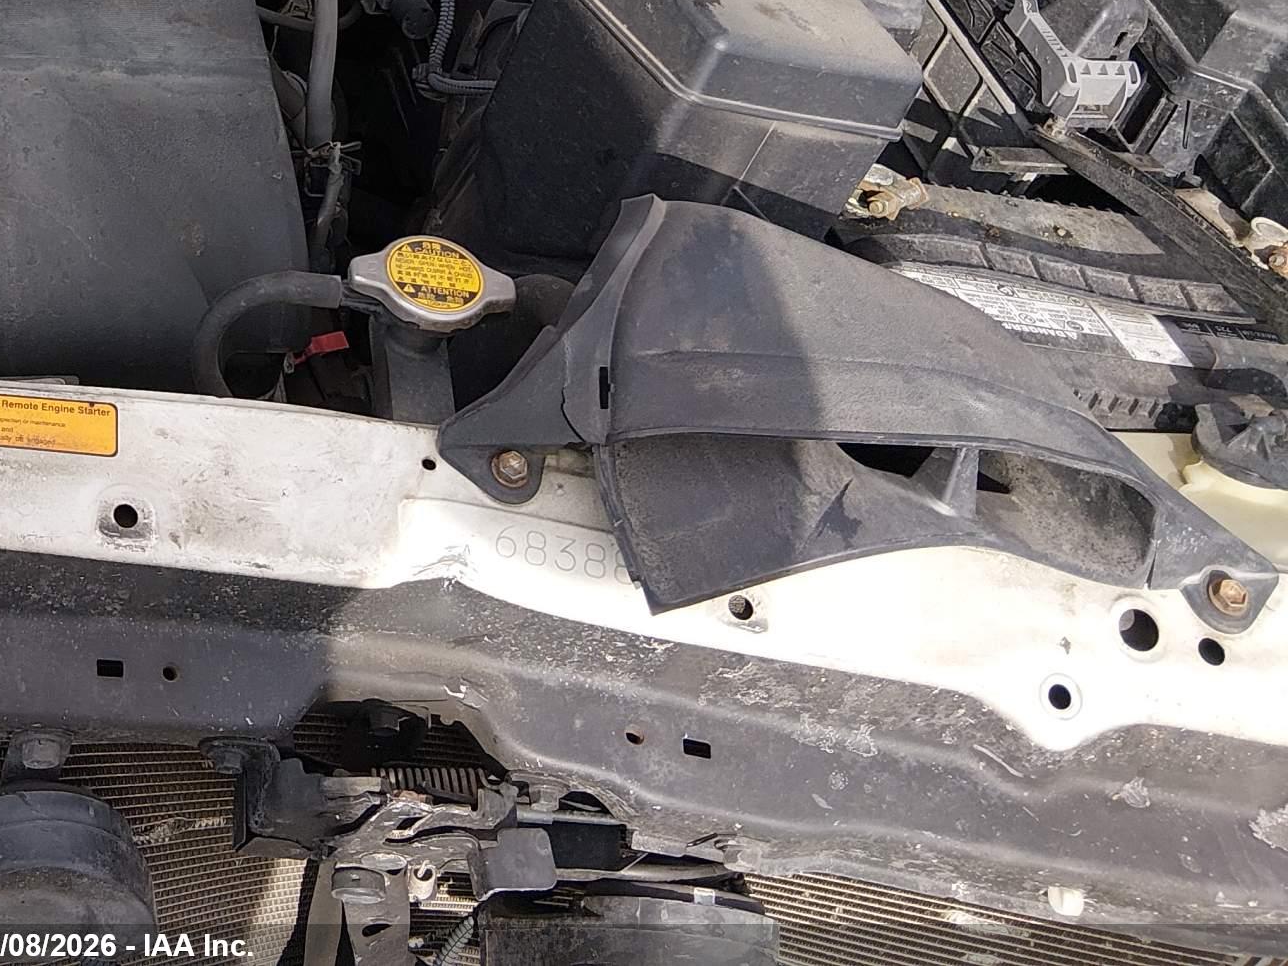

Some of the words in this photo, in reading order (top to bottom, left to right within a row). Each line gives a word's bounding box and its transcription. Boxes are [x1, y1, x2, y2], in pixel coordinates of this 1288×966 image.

[415, 247, 460, 259] CAUTION
[420, 285, 470, 298] ATTENTION
[1, 400, 39, 411] Remote
[41, 403, 75, 414] Engine
[78, 406, 111, 417] Starter
